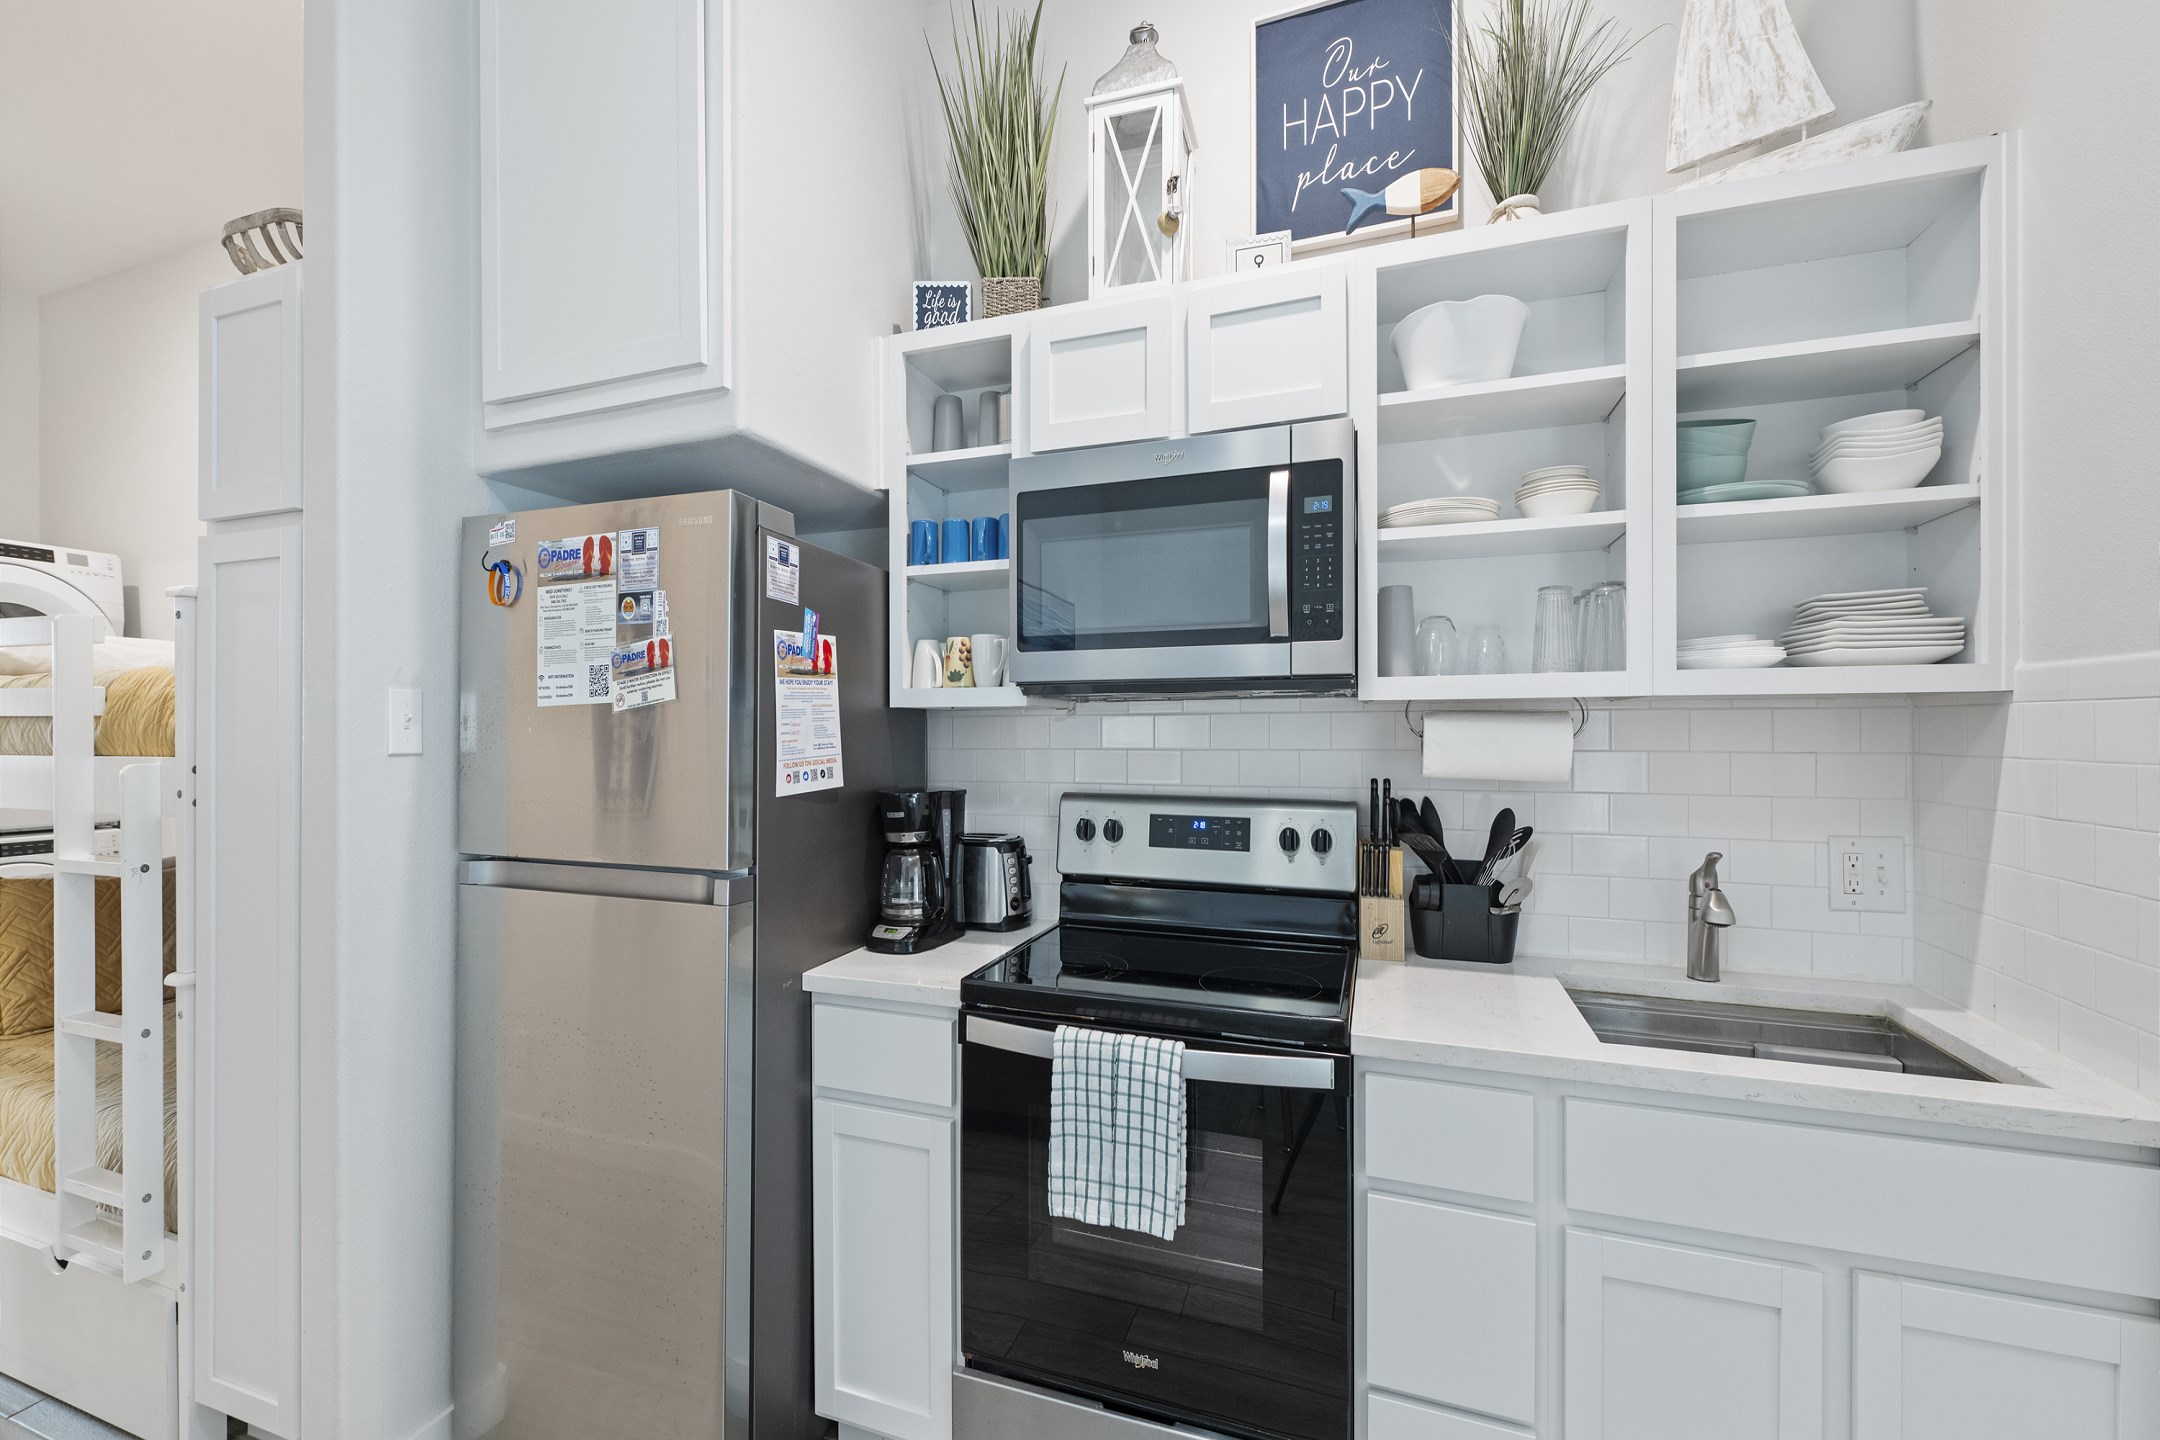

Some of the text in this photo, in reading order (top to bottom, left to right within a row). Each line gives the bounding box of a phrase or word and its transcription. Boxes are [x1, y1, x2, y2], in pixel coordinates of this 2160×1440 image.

[1323, 37, 1390, 88] Our
[1283, 68, 1423, 151] HAPPY
[1291, 143, 1416, 213] place
[922, 290, 957, 312] Life is
[924, 300, 961, 329] good
[1123, 350, 1158, 369] Whirlpool
[678, 514, 713, 527] SAMSUNG
[551, 548, 582, 563] PADRE
[621, 650, 646, 663] PADRE
[783, 761, 799, 769] FOLLOW
[812, 758, 826, 766] SOCIAL
